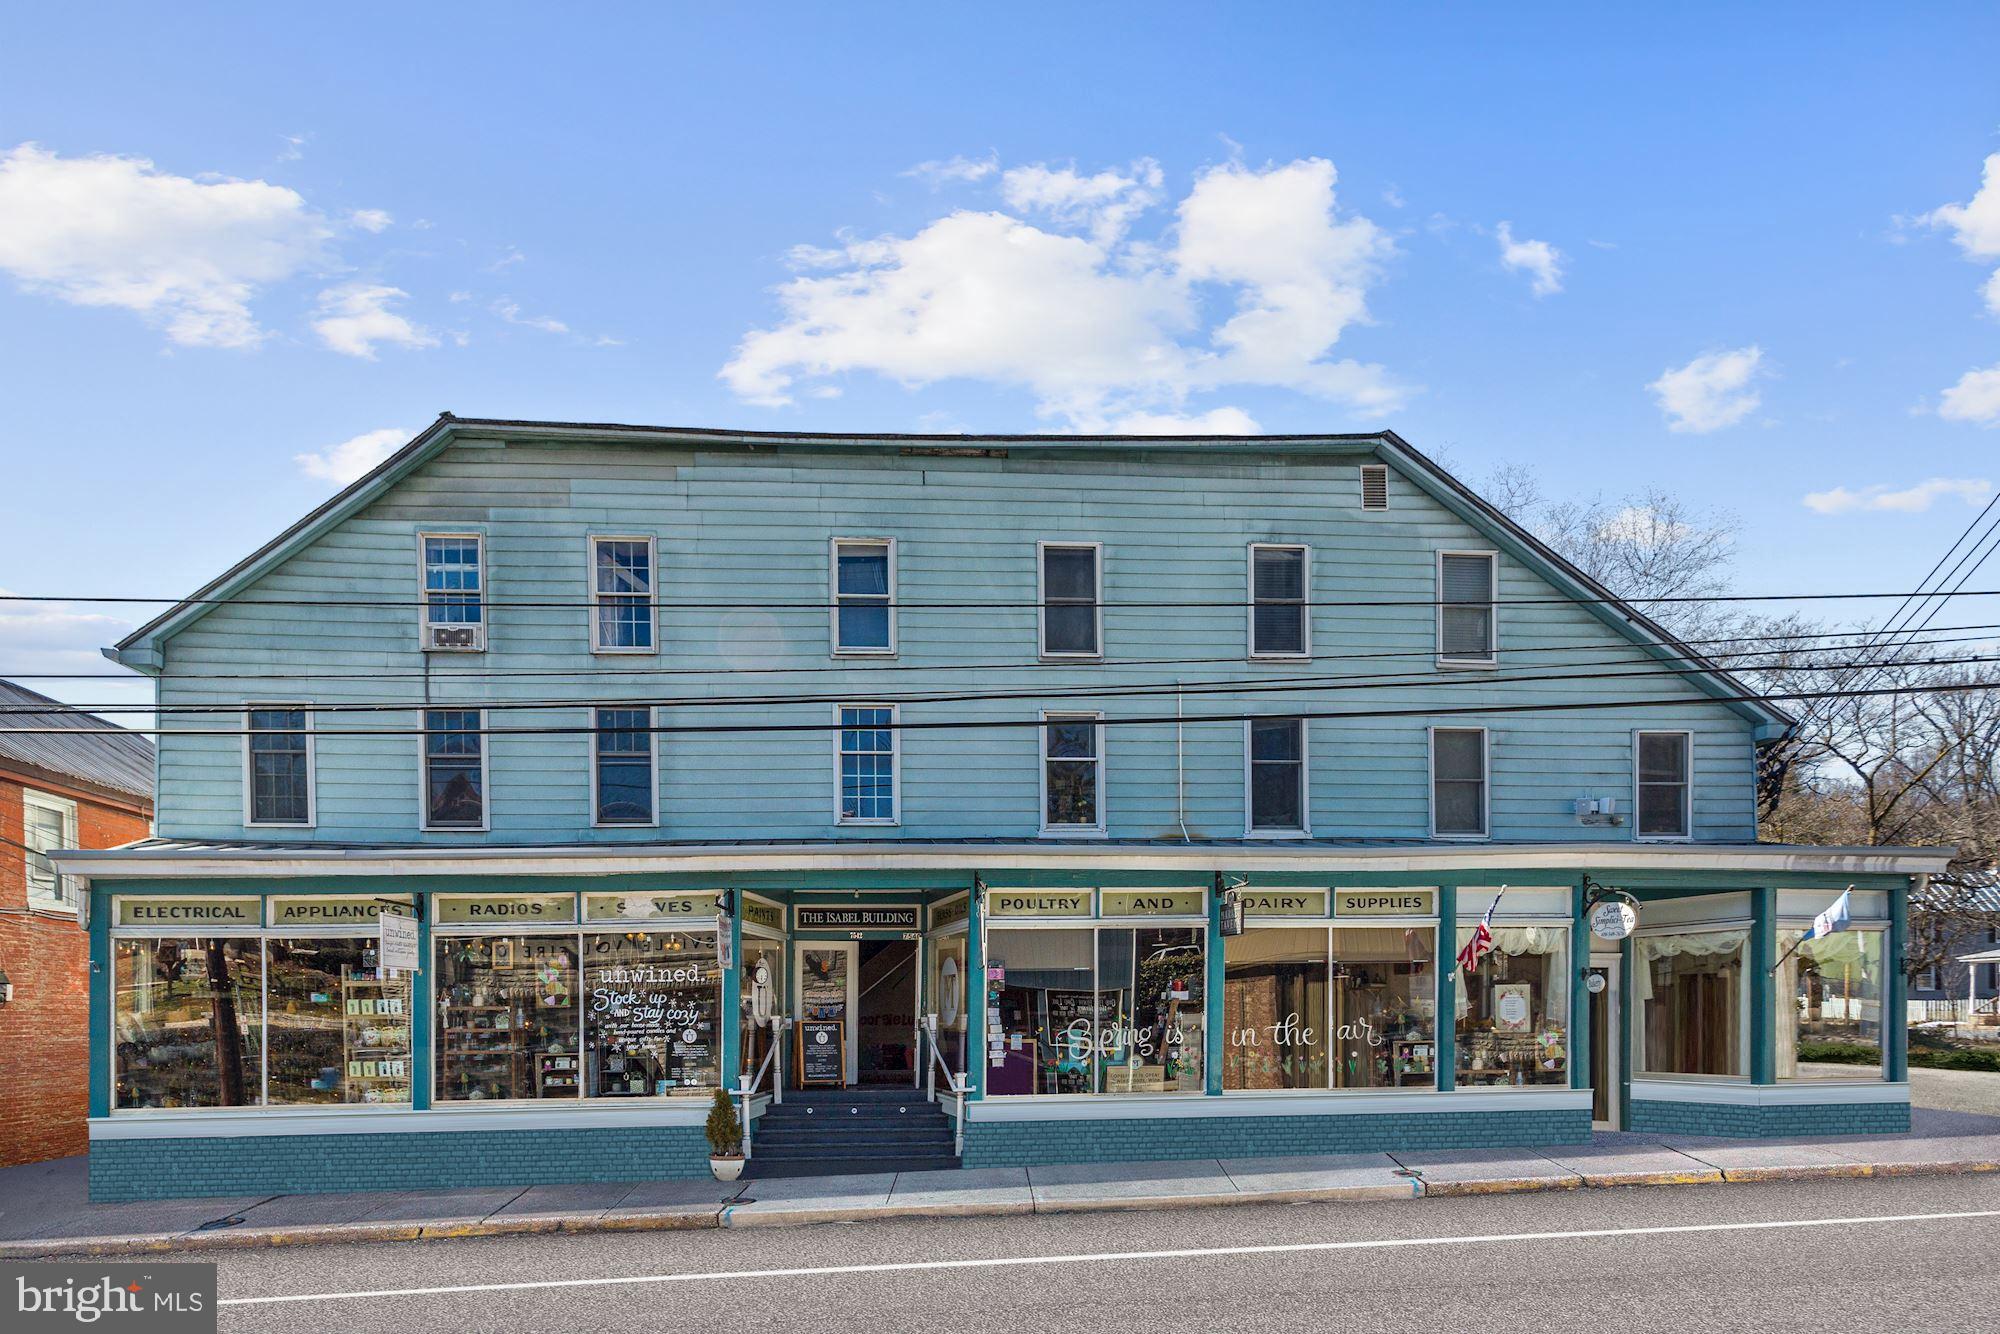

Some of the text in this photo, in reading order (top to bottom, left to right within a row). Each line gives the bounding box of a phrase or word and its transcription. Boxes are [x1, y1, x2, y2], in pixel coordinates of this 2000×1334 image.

[469, 903, 543, 916] RADIOS
[616, 901, 693, 914] SVES
[1000, 898, 1081, 910] POULTRY
[1133, 898, 1174, 909] AND
[1243, 898, 1308, 909] DAIRY
[1346, 897, 1423, 909] SUPPLIES
[133, 906, 246, 919] ELECTRICAL
[748, 905, 774, 921] PAINTS
[801, 912, 914, 924] THE ISABEL BUILDING
[599, 964, 705, 983] unwined.
[593, 988, 667, 1011] Stock up
[613, 1008, 630, 1018] AND
[667, 1010, 699, 1026] cozy
[1231, 1012, 1382, 1046] in the air
[1066, 1018, 1184, 1060] Spring is
